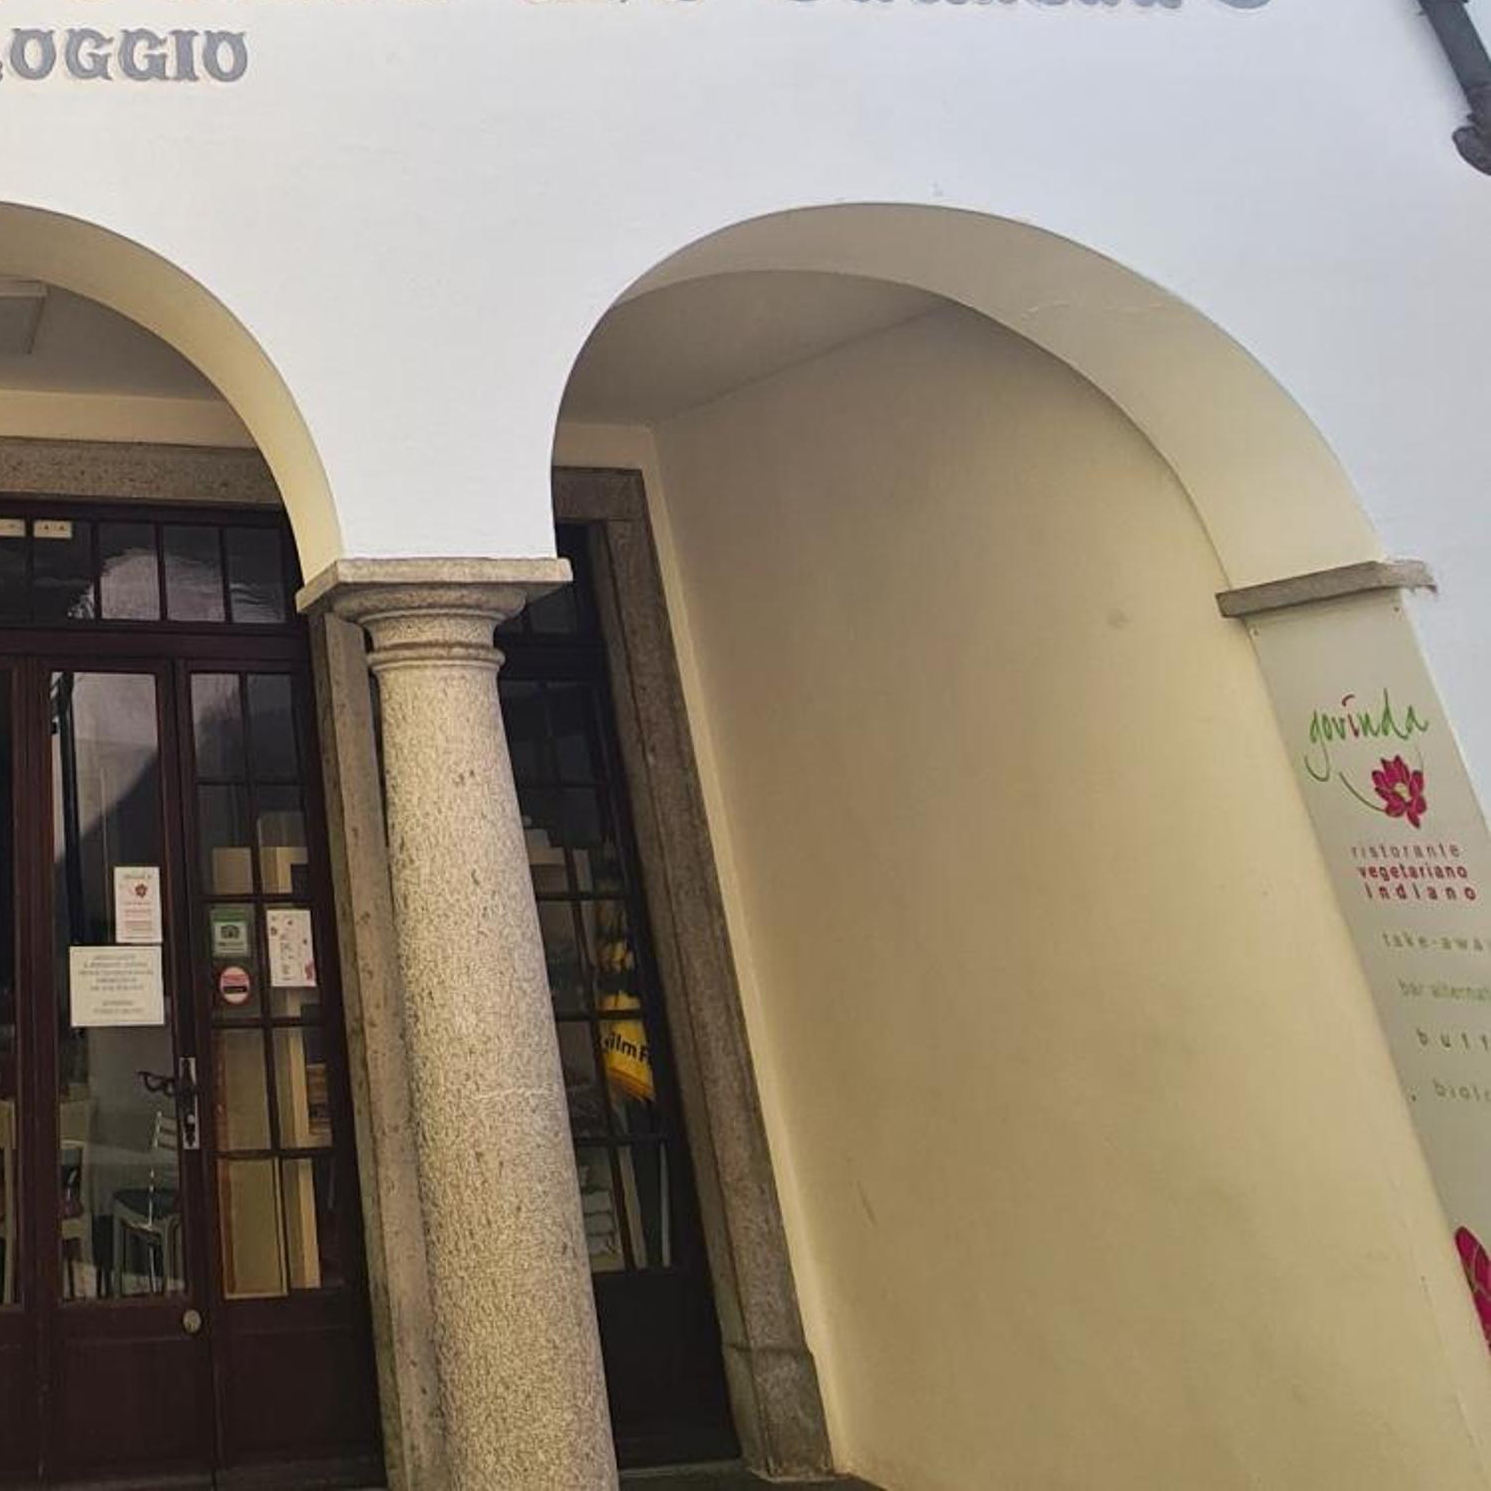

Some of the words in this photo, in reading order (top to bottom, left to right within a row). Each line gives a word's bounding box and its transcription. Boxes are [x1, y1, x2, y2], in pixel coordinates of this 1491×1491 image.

[1304, 687, 1430, 782] govinda
[1350, 842, 1461, 860] ristorante
[1357, 863, 1469, 882] vegetariano
[1381, 931, 1491, 952] take-awa
